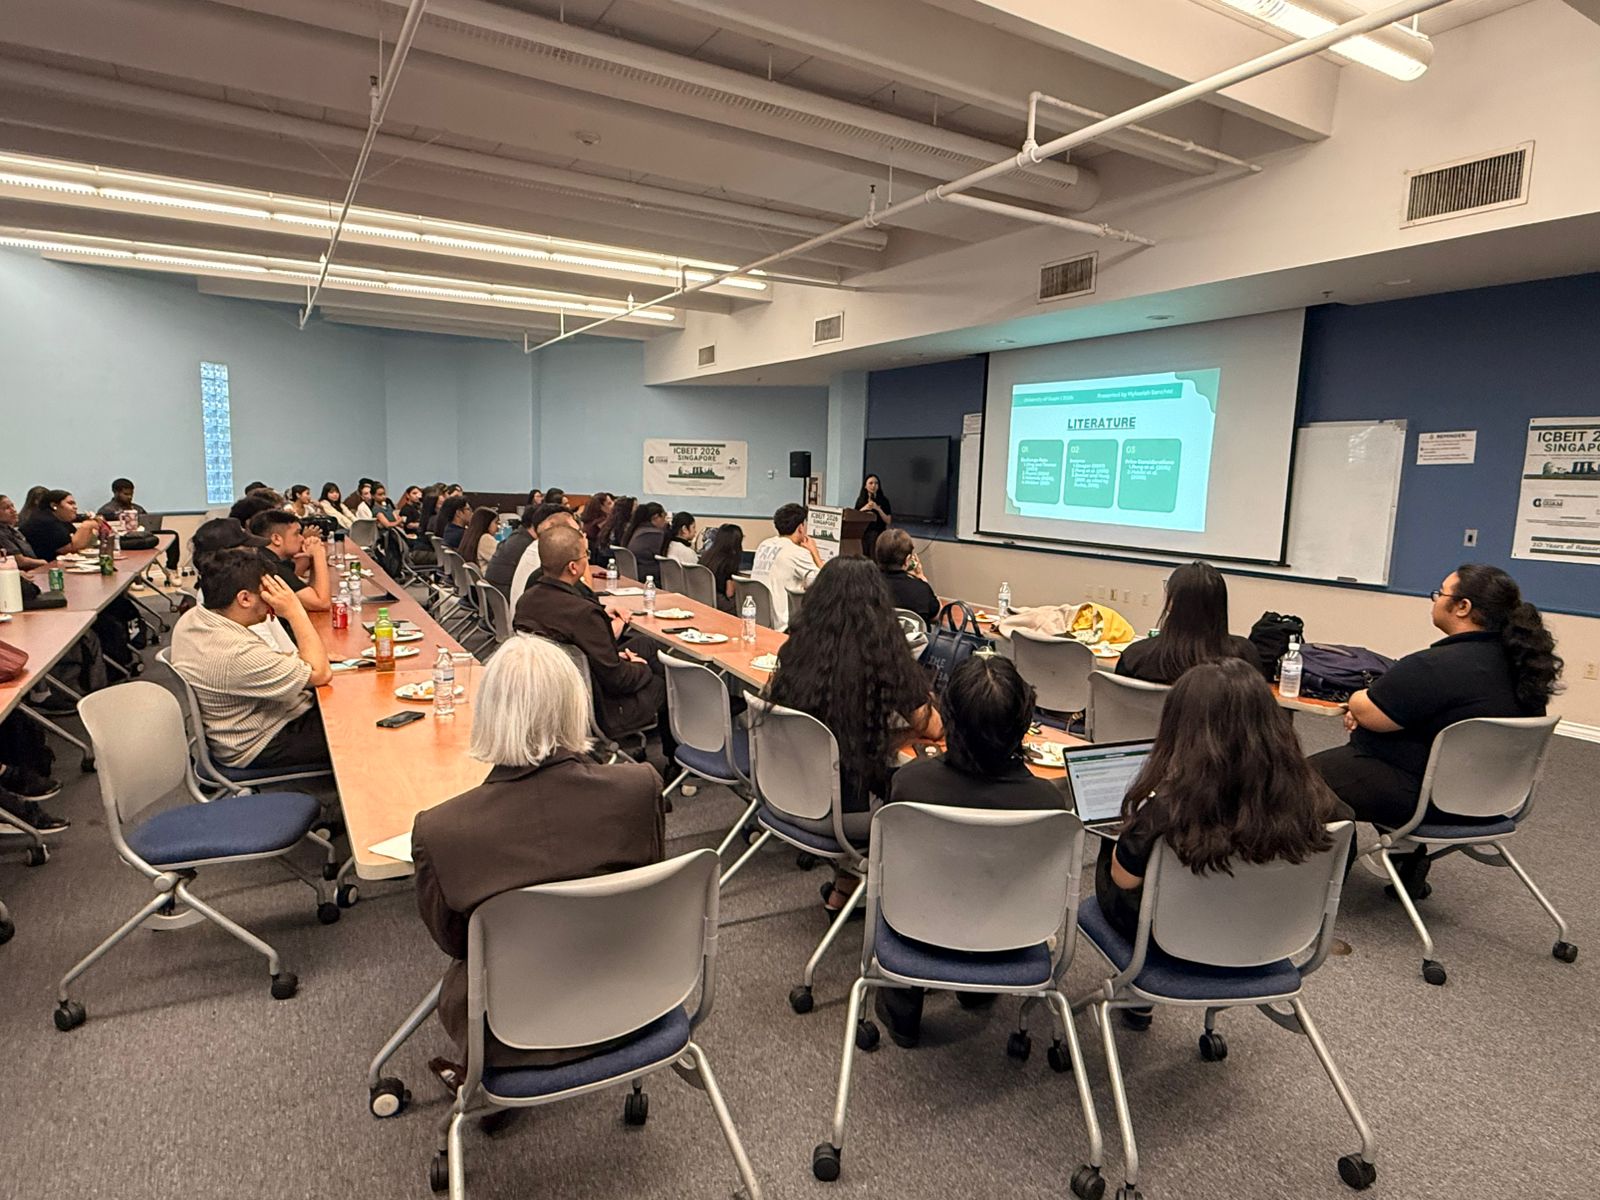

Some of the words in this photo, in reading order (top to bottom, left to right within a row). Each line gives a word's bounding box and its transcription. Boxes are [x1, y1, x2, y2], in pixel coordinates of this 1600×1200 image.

[1067, 417, 1136, 429] LITERATURE
[1537, 431, 1588, 442] ICBEIT
[673, 447, 698, 455] ICBEIT
[700, 447, 720, 456] 2026
